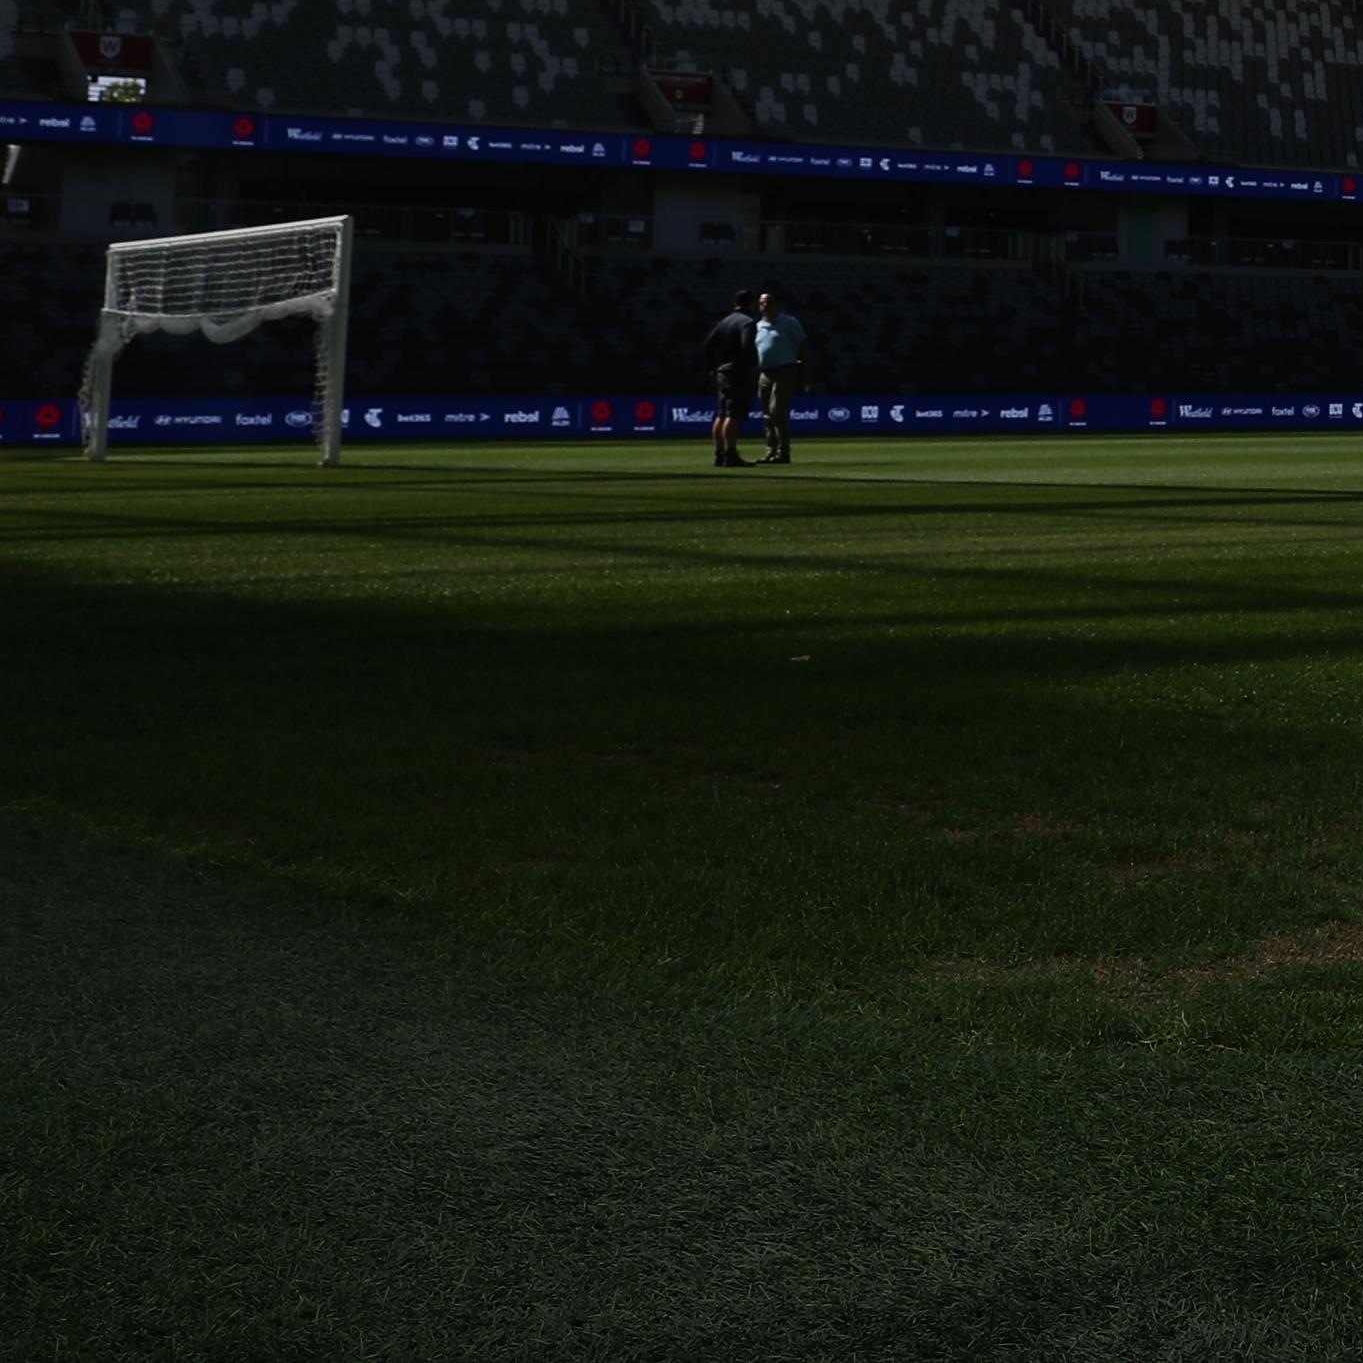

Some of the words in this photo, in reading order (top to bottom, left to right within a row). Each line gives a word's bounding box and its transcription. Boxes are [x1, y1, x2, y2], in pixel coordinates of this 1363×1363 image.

[235, 413, 273, 426] foxtel
[503, 410, 540, 424] rebel
[789, 408, 819, 420] foxtel
[999, 407, 1029, 419] rebel
